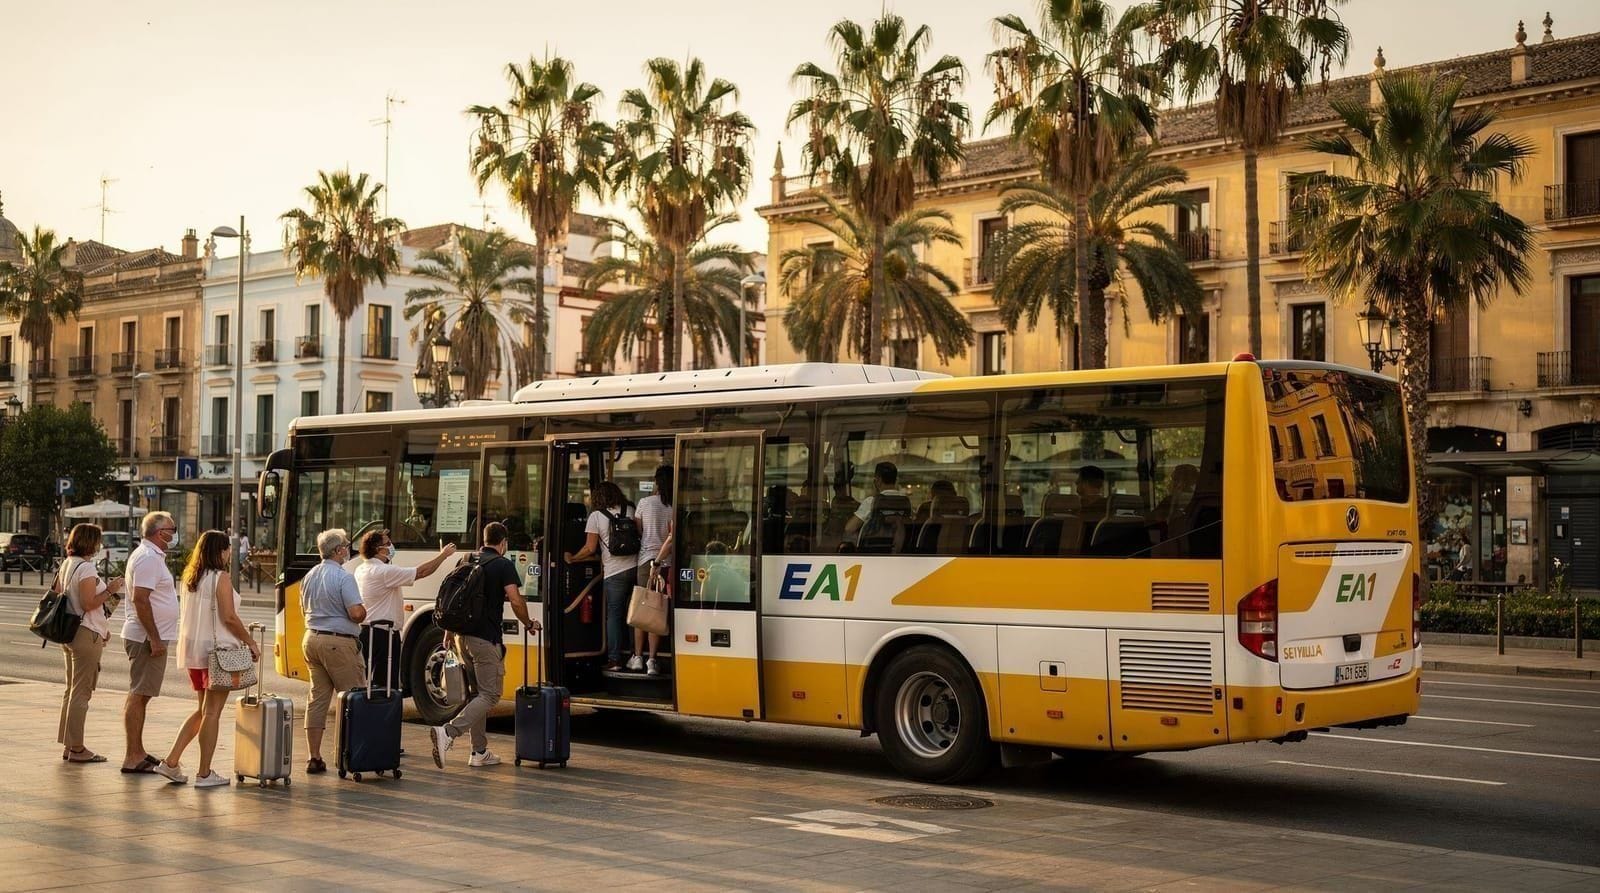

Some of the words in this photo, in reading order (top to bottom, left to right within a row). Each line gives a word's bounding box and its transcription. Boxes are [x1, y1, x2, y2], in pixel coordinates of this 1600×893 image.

[59, 479, 71, 494] P
[778, 563, 863, 602] EA1
[1335, 572, 1377, 603] EA1
